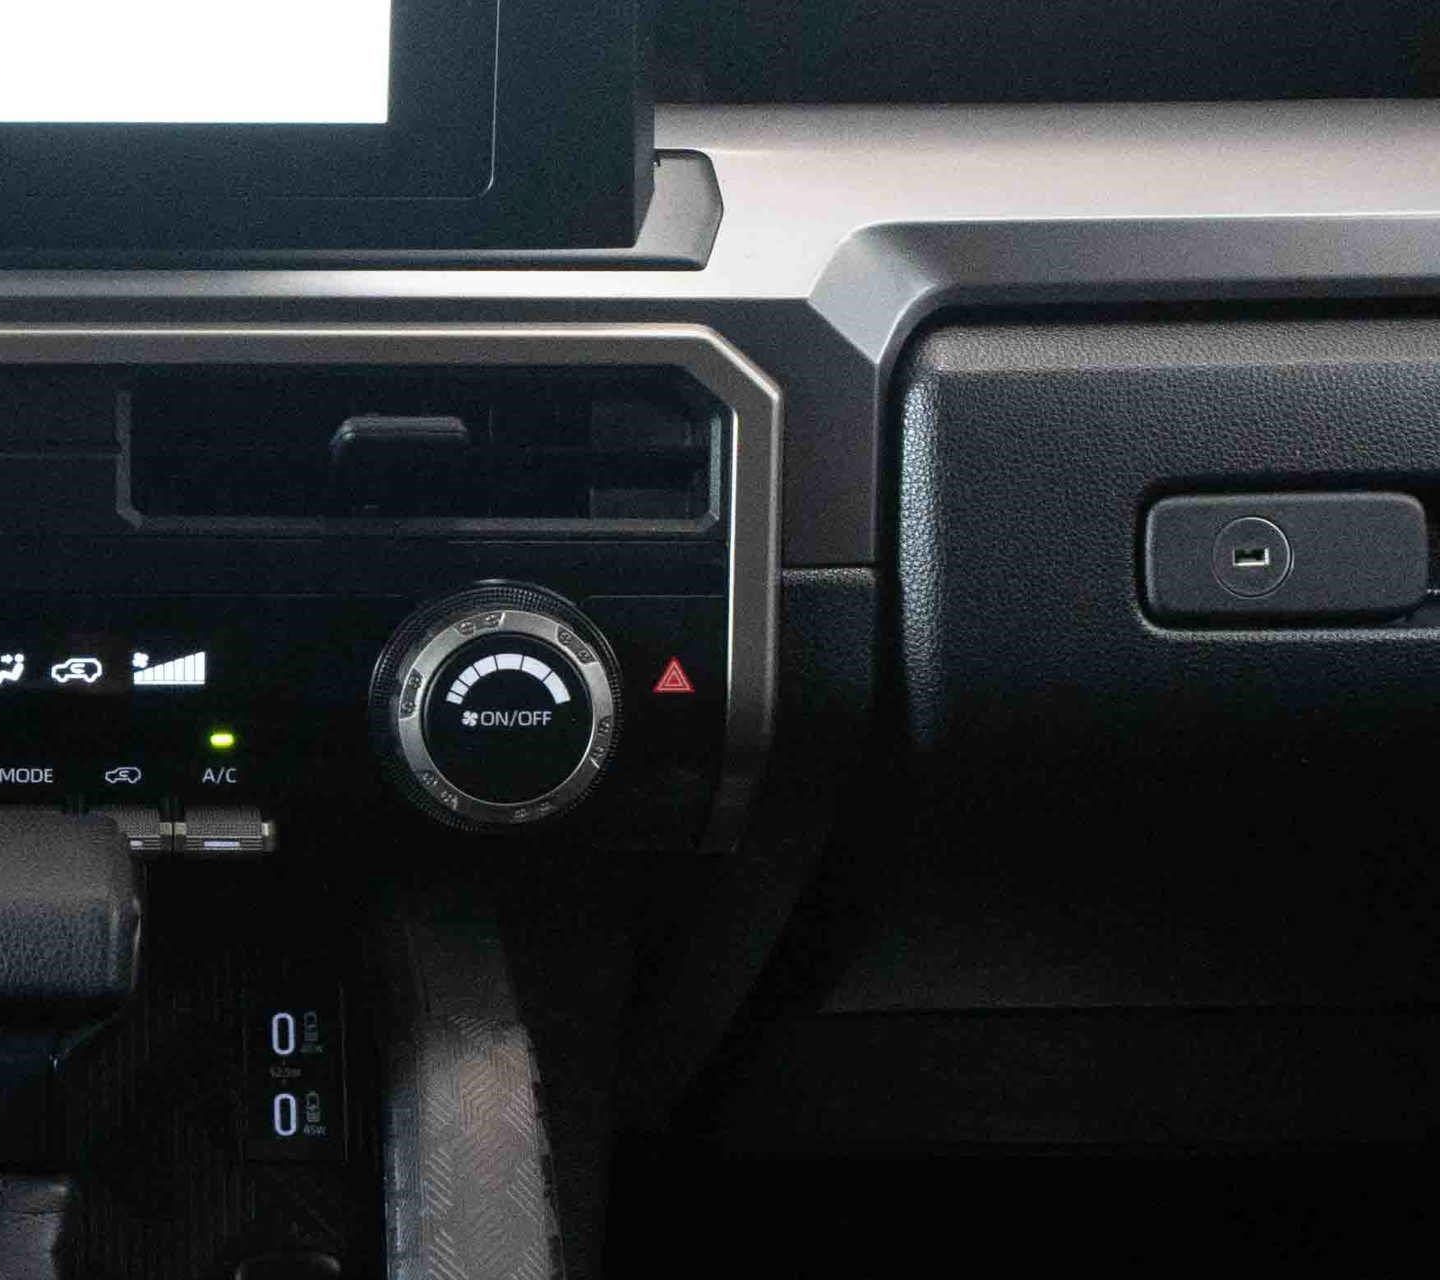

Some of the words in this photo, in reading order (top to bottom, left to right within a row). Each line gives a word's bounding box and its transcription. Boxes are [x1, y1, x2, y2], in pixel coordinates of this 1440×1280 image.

[481, 710, 553, 727] ON/OFF
[0, 768, 54, 783] MODE
[202, 768, 238, 783] A/C
